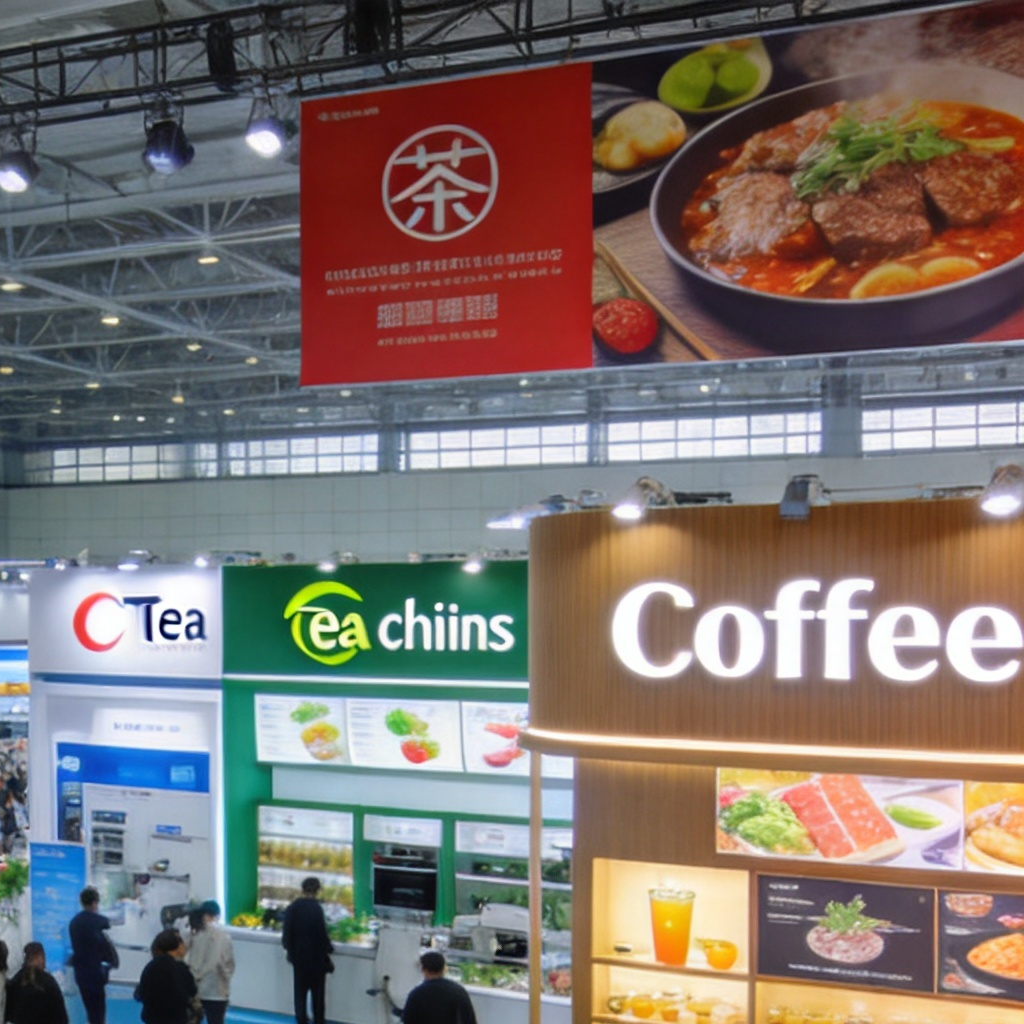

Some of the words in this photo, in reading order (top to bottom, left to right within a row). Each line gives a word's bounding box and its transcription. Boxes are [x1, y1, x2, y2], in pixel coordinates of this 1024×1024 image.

[389, 137, 490, 233] 茶
[378, 597, 515, 652] chiins
[612, 578, 1024, 682] Coffee
